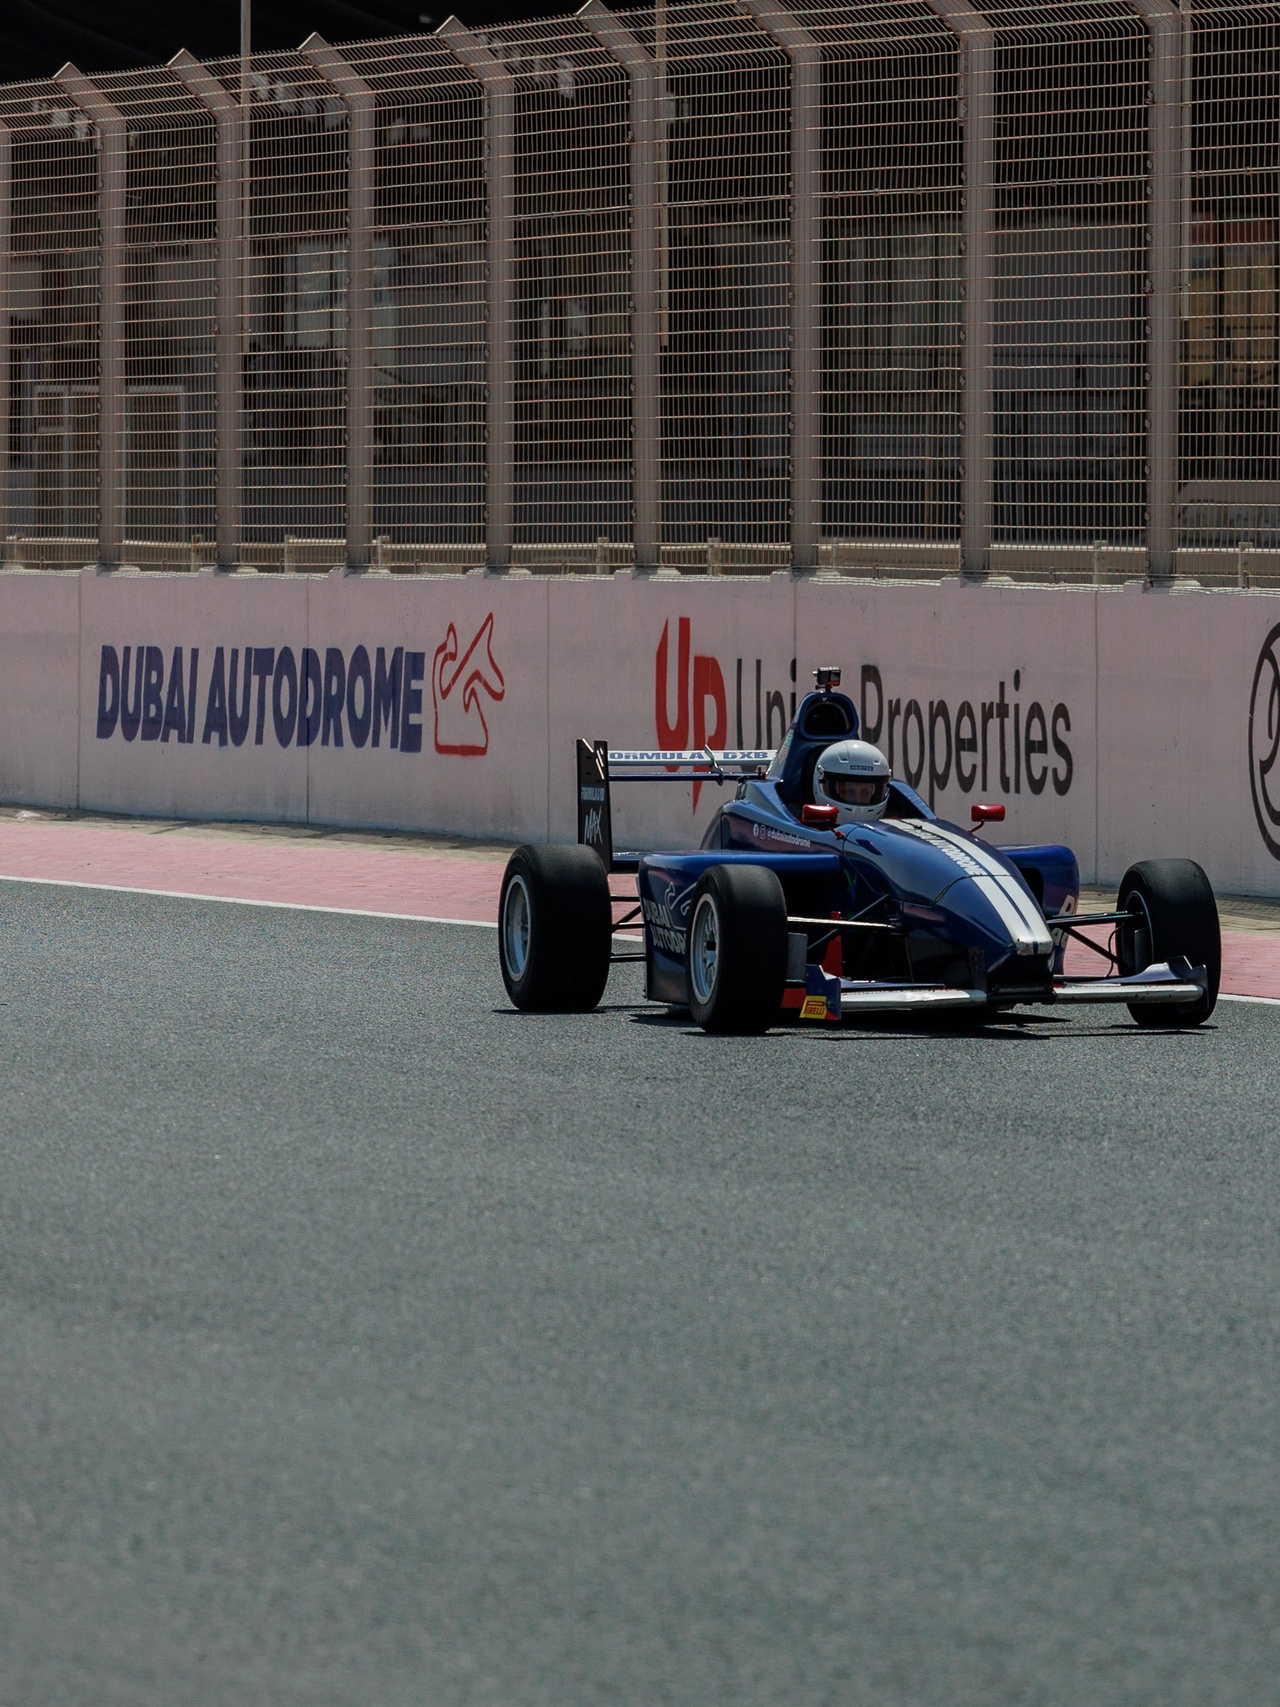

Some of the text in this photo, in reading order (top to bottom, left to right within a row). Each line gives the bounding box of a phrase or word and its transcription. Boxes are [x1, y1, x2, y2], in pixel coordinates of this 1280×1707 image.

[97, 644, 426, 753] DUBAI AUTODROME
[736, 658, 797, 772] Uni
[860, 664, 1073, 814] Properties
[608, 752, 705, 760] ORMULA
